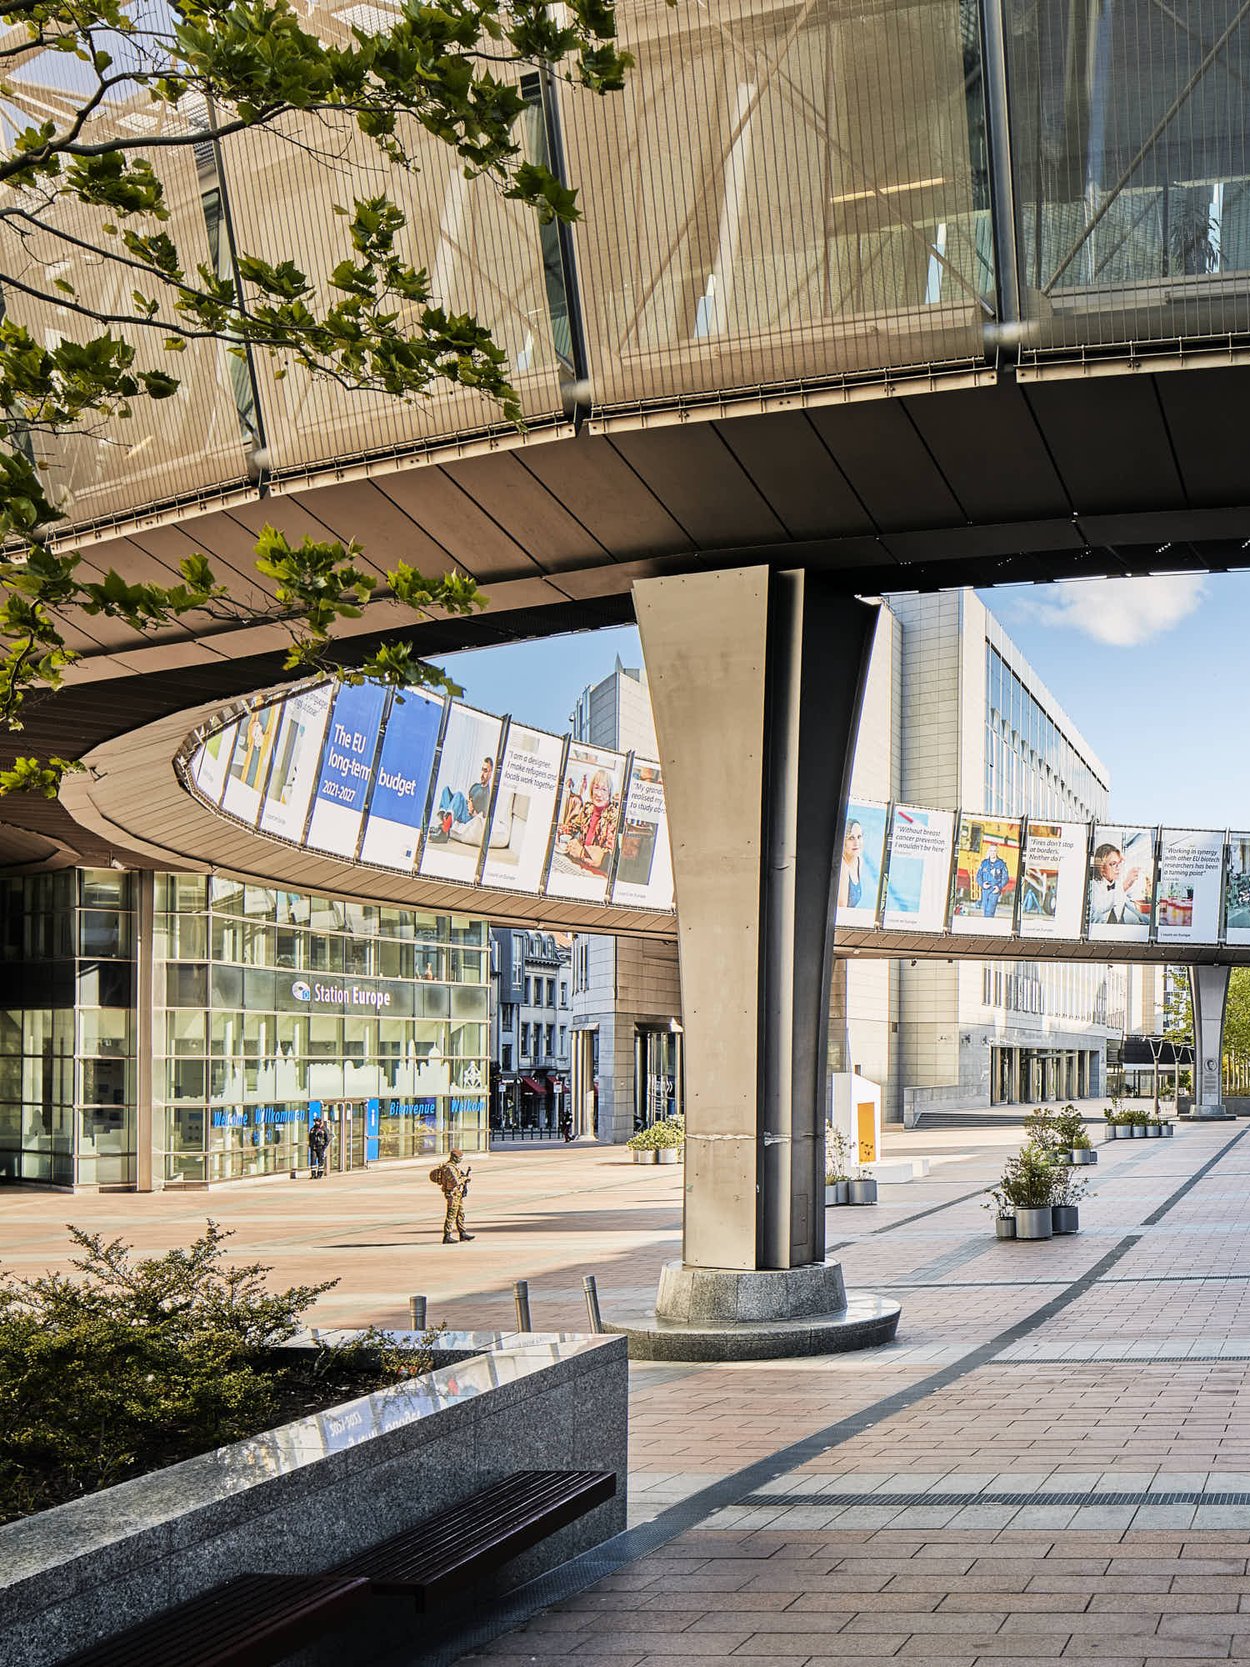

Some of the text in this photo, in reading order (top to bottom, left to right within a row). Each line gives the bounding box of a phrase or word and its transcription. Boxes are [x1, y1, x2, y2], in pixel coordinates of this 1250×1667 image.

[335, 724, 366, 753] The EU
[328, 746, 416, 796] long-term budget
[505, 770, 520, 782] locals
[510, 763, 525, 772] make
[526, 767, 546, 778] refugees
[322, 780, 356, 802] 2021-2027
[632, 793, 654, 802] realised
[638, 804, 653, 813] study
[314, 984, 391, 1009] Station Europe
[255, 1107, 305, 1124] Willkommen
[390, 1101, 436, 1116] Bienvenue
